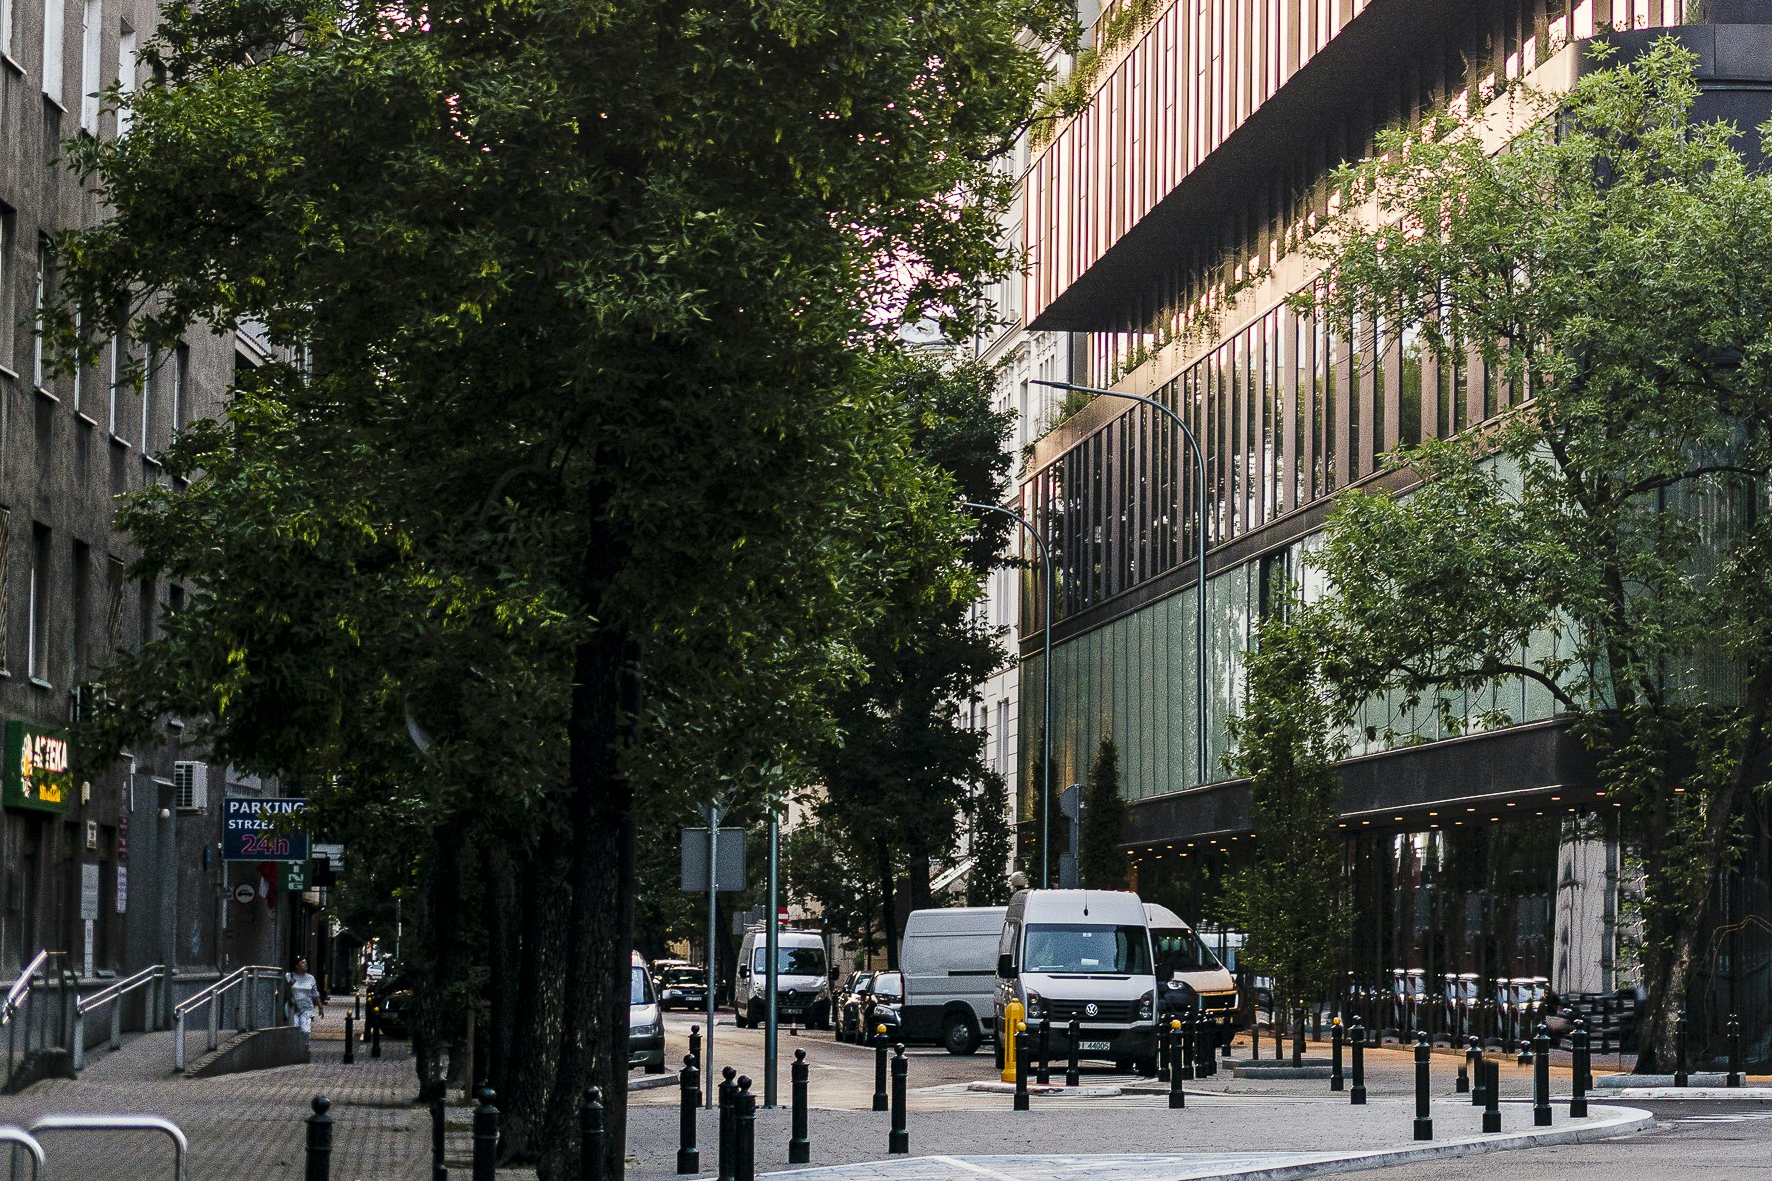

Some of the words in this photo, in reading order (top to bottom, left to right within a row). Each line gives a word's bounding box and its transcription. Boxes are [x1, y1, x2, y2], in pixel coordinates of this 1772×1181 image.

[229, 801, 305, 815] PARKING
[228, 819, 304, 830] STRZE
[241, 833, 290, 855] 24h
